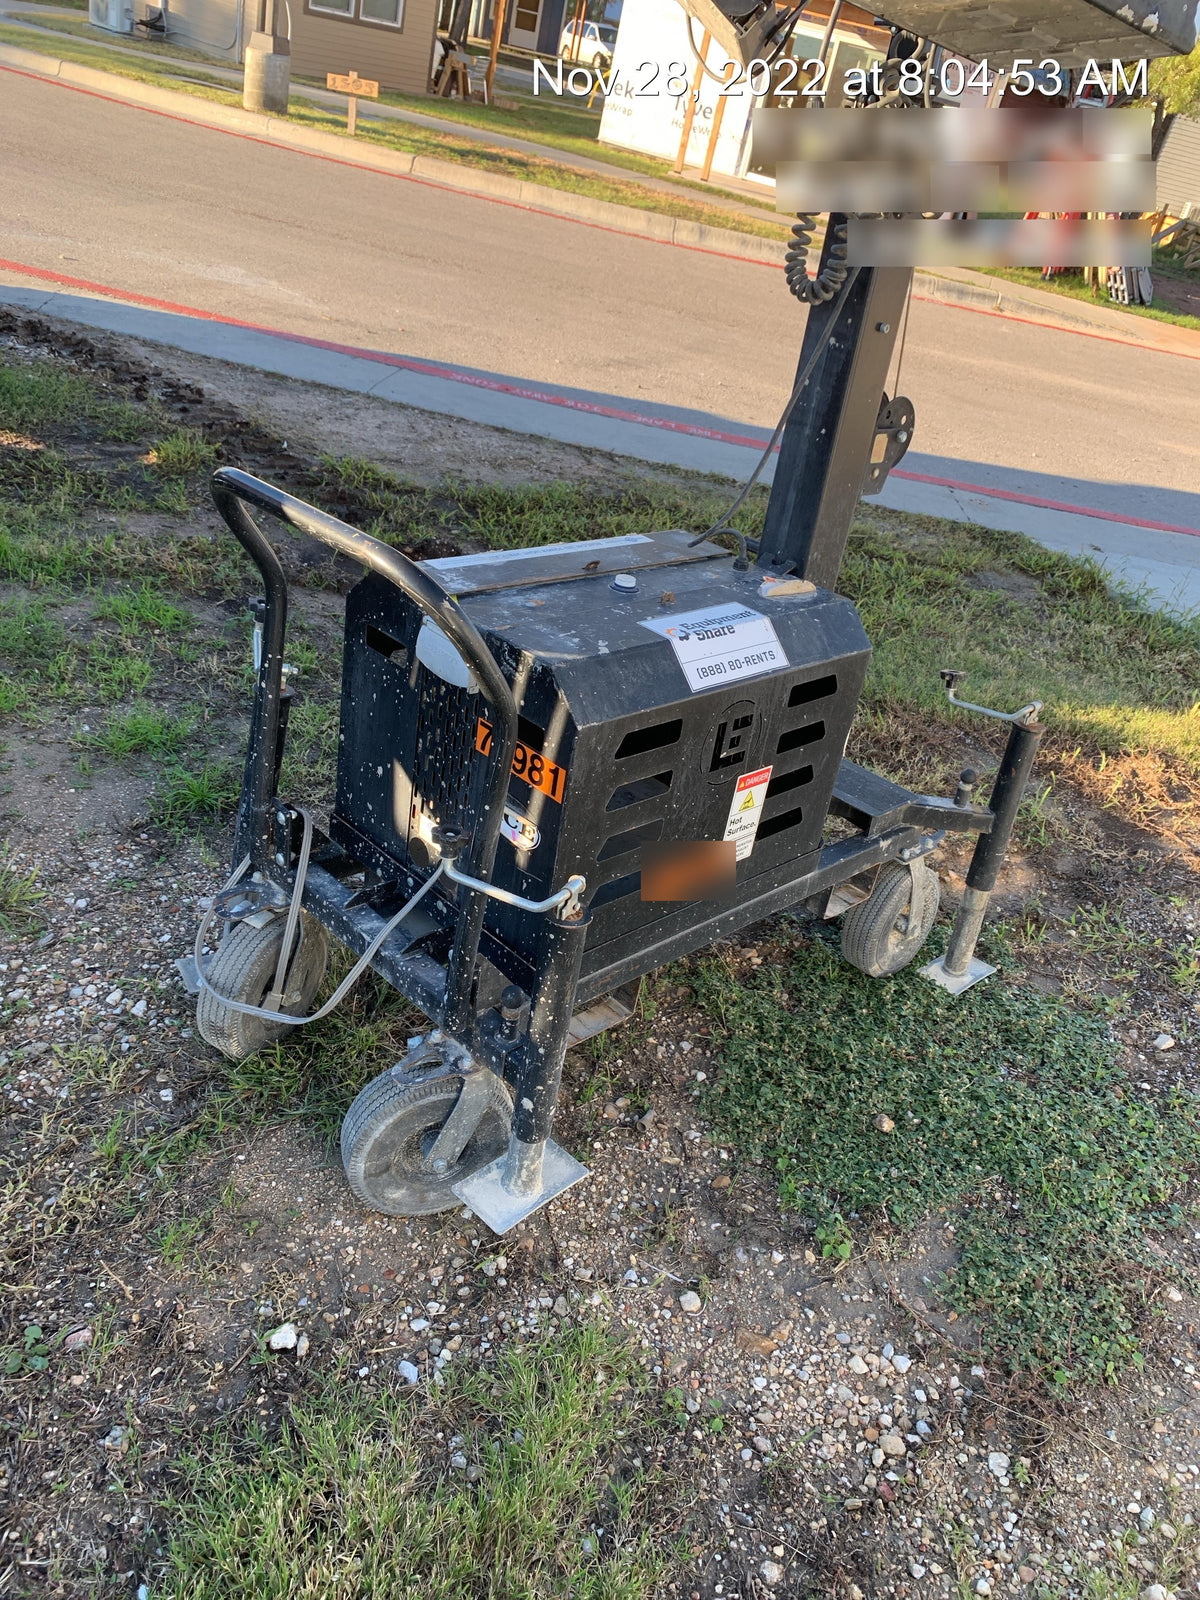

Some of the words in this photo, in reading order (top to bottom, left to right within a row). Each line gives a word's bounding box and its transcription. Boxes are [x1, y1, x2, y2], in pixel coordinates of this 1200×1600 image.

[680, 609, 757, 632] Equipment
[693, 624, 736, 641] Share
[696, 662, 727, 679] (888)
[728, 650, 776, 671] 80-RENTS
[745, 772, 769, 787] DANGER
[727, 822, 756, 837] Surface.
[729, 816, 743, 827] Hot
